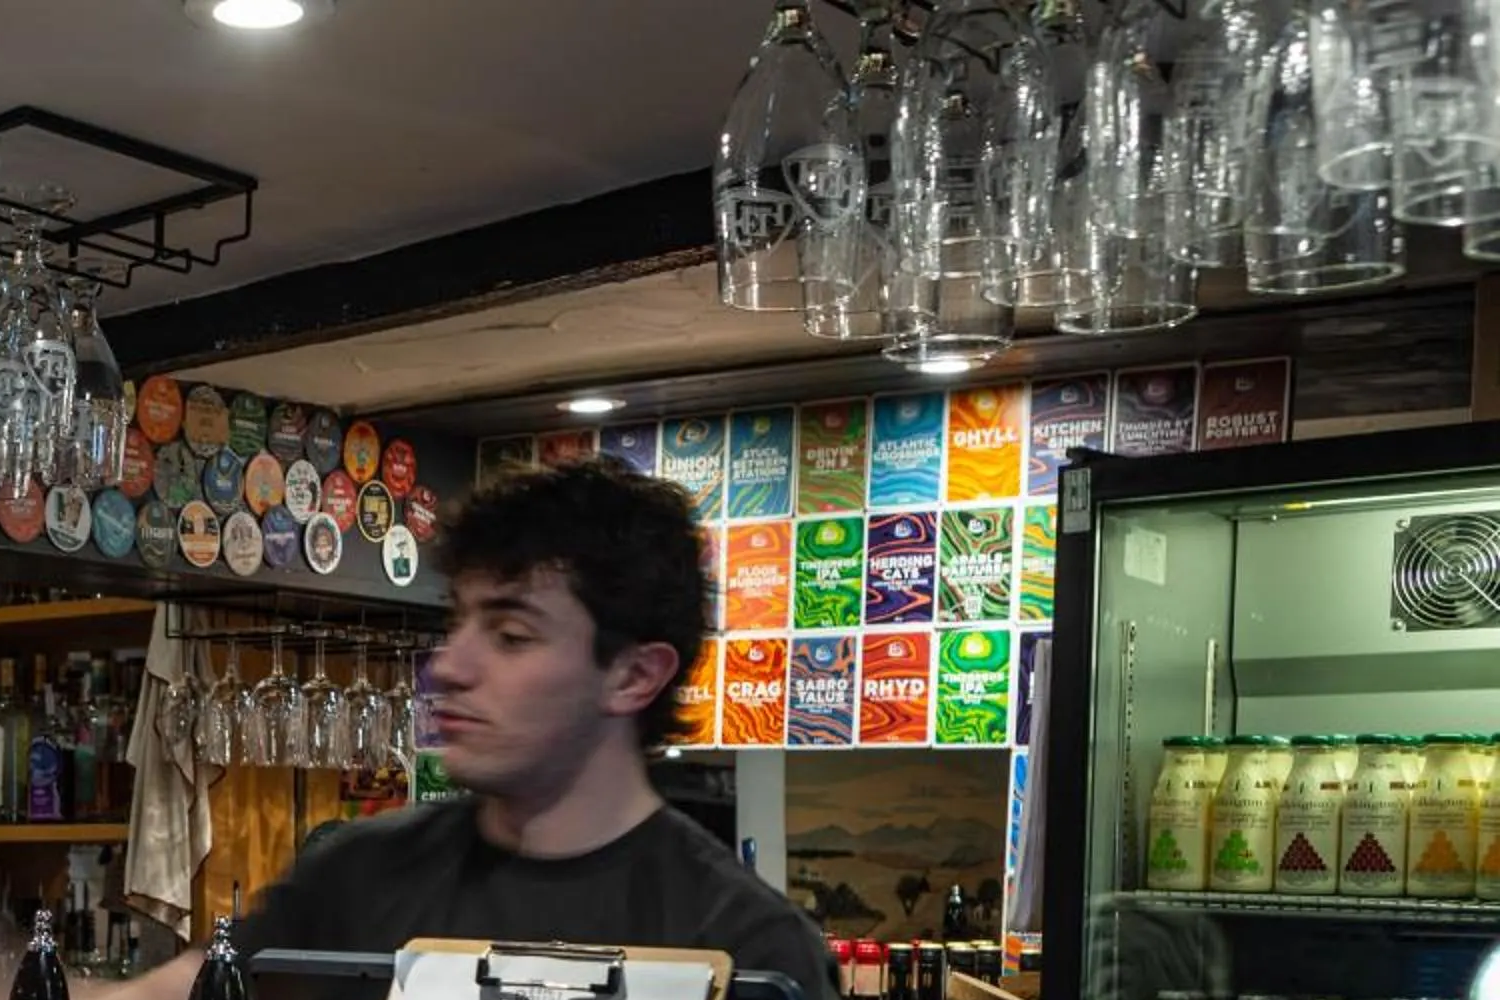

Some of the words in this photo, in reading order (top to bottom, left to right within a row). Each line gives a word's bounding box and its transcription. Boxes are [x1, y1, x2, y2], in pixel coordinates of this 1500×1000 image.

[1207, 412, 1278, 428] ROBUST
[1033, 419, 1105, 439] KITCHEN
[953, 428, 1019, 448] GHYLL
[1049, 437, 1087, 450] SINK
[666, 455, 720, 473] UNION
[870, 554, 933, 569] HERDING
[817, 568, 841, 581] IPA
[883, 567, 920, 580] CATS
[727, 680, 781, 698] CRAG
[796, 678, 848, 692] SABRO
[864, 678, 925, 698] RHYD
[960, 681, 986, 694] IPA
[799, 691, 845, 705] TALUS
